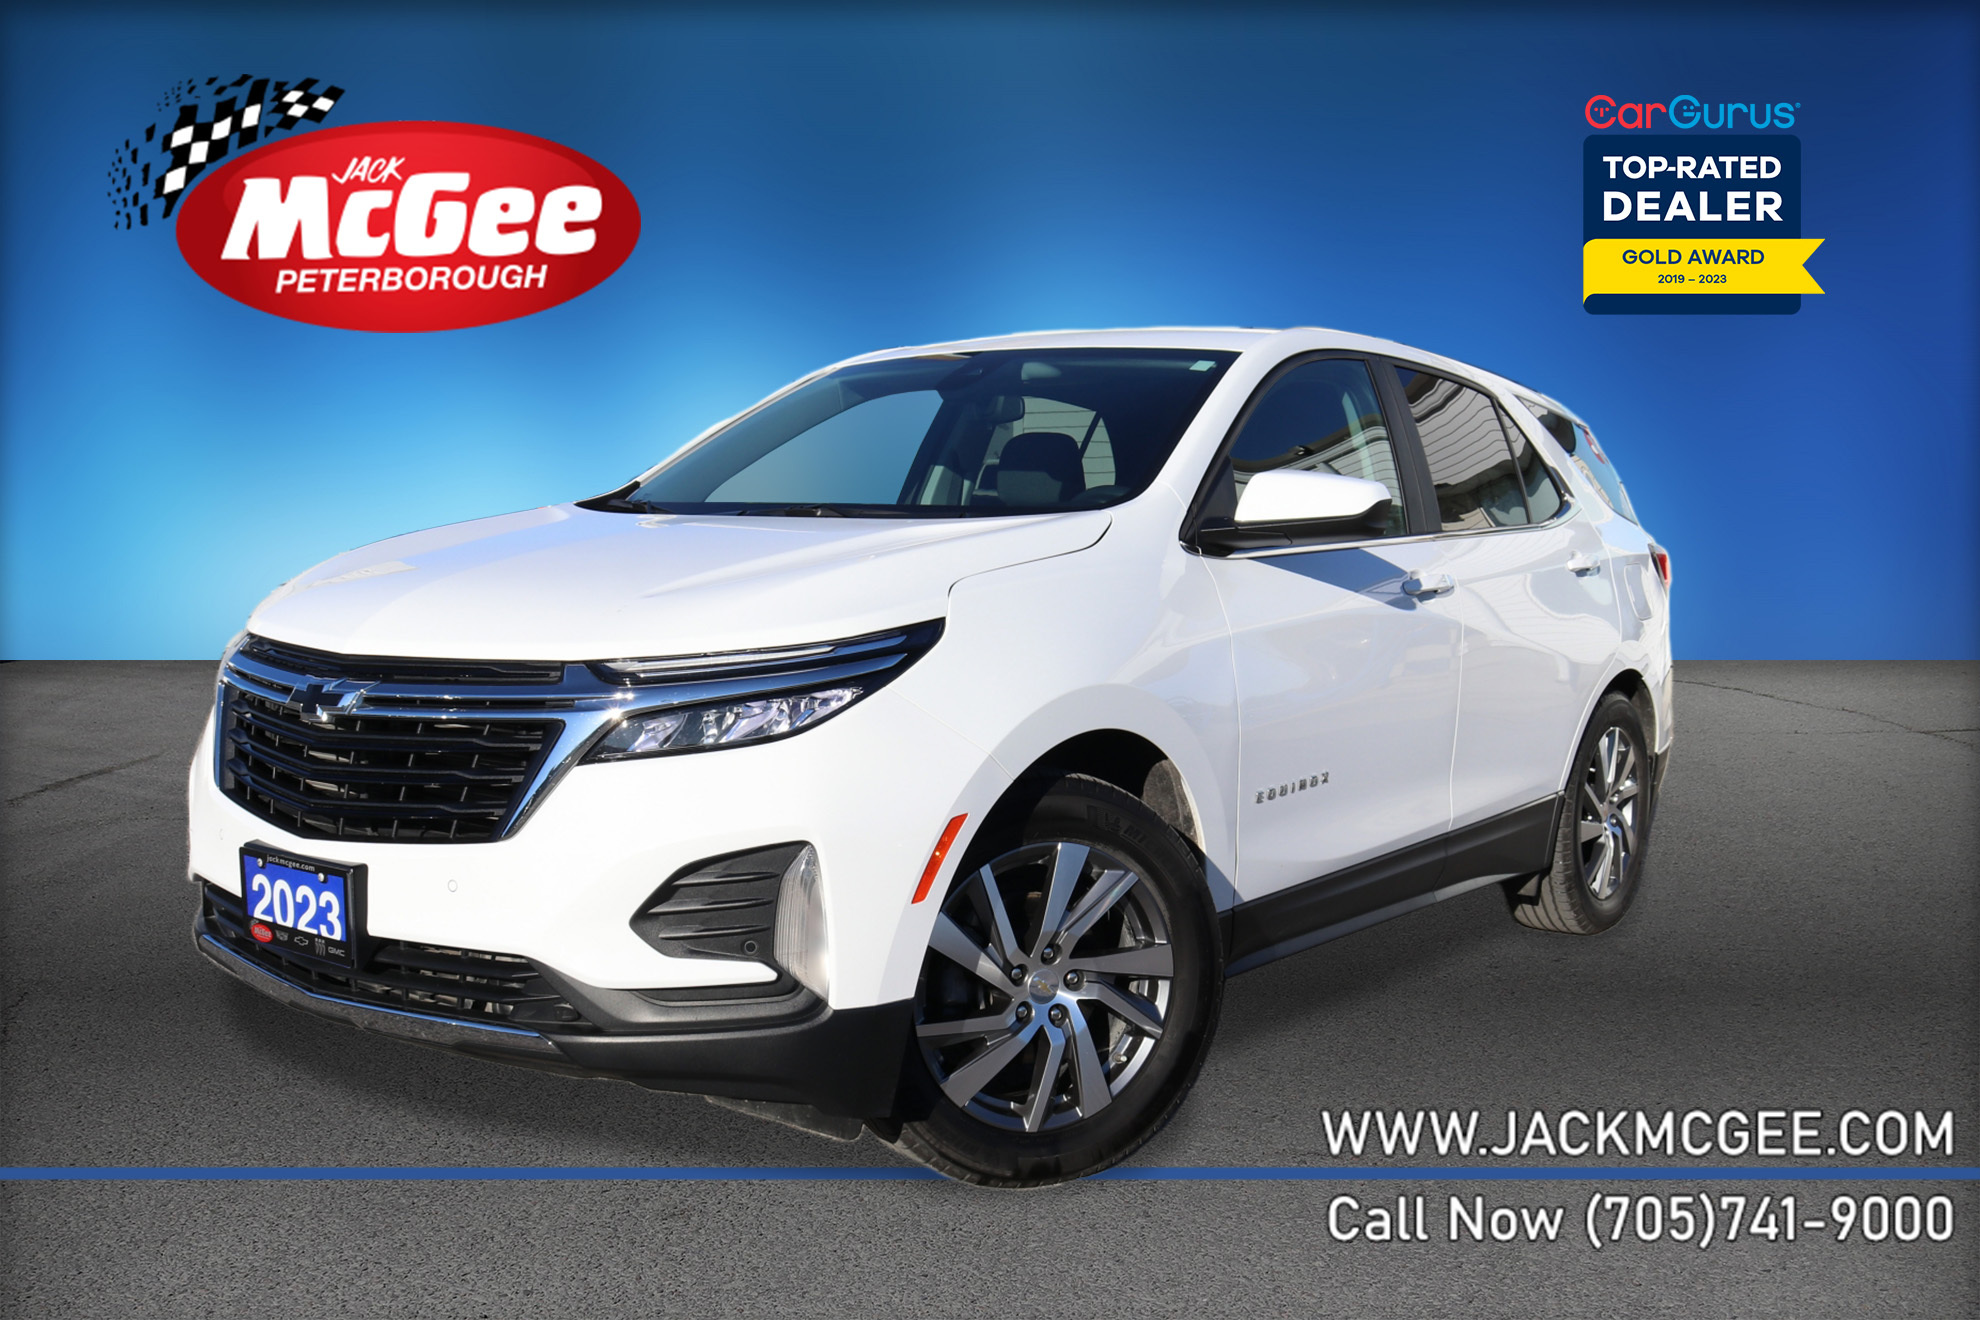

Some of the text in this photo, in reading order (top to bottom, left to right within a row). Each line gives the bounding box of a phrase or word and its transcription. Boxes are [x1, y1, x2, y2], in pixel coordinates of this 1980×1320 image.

[1255, 771, 1330, 804] EQUINOX
[252, 873, 342, 941] 2023
[327, 946, 346, 957] GMC
